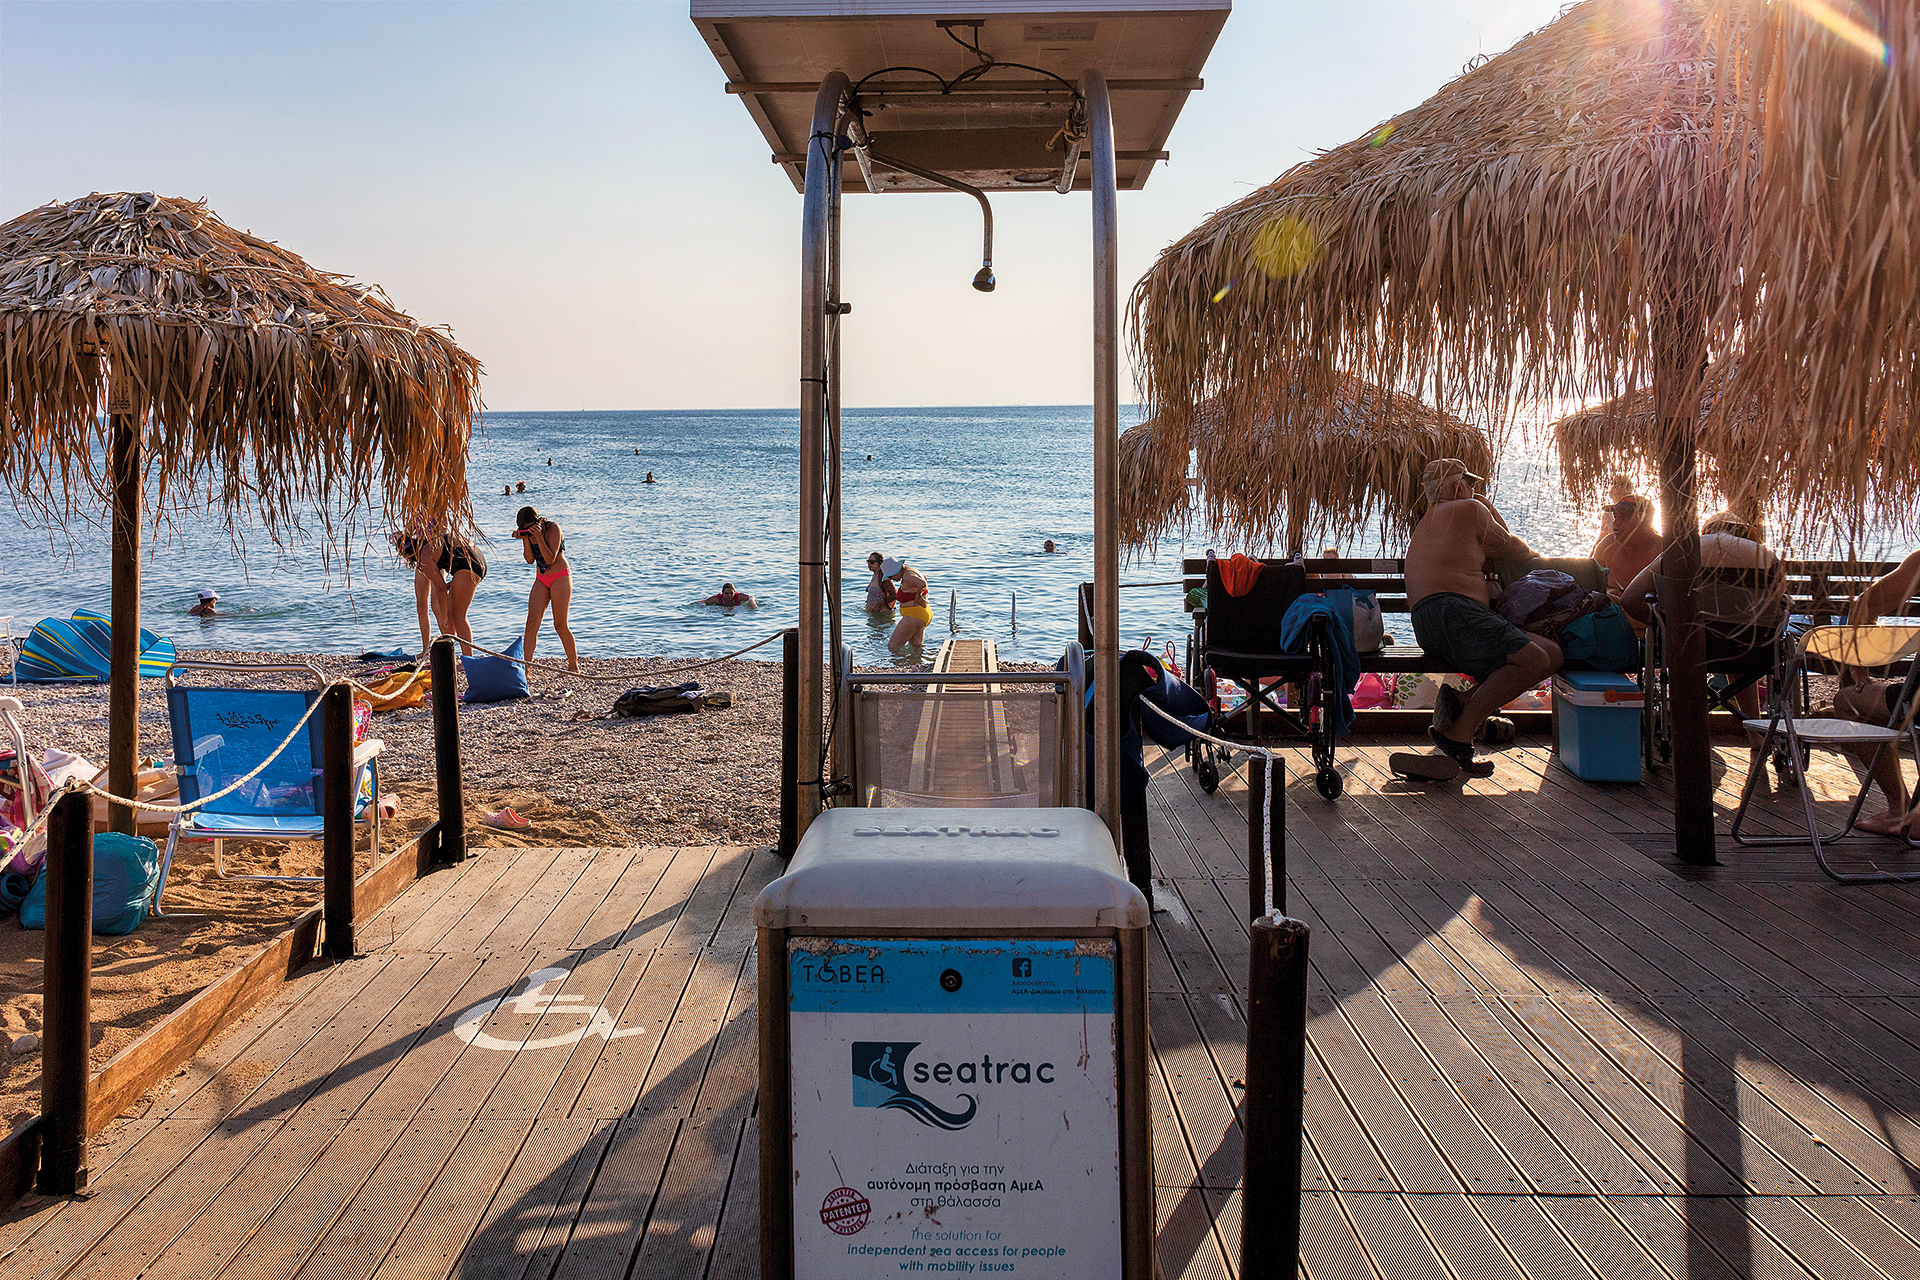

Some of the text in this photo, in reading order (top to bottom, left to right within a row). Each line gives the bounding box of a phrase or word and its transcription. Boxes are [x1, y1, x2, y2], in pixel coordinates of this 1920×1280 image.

[853, 825, 1061, 838] SEATRAC
[913, 1054, 1055, 1084] seatrac
[905, 1162, 1005, 1177] Διάταξη για την
[867, 1178, 1044, 1193] αυτόνομη πρόσβαση ΑμεΑ
[910, 1194, 1001, 1209] στη θάλασσα
[822, 1202, 869, 1222] PATENTED
[911, 1229, 1002, 1241] The solution for
[847, 1243, 1067, 1259] independent sea access for people
[899, 1260, 1016, 1274] with mobility issues
